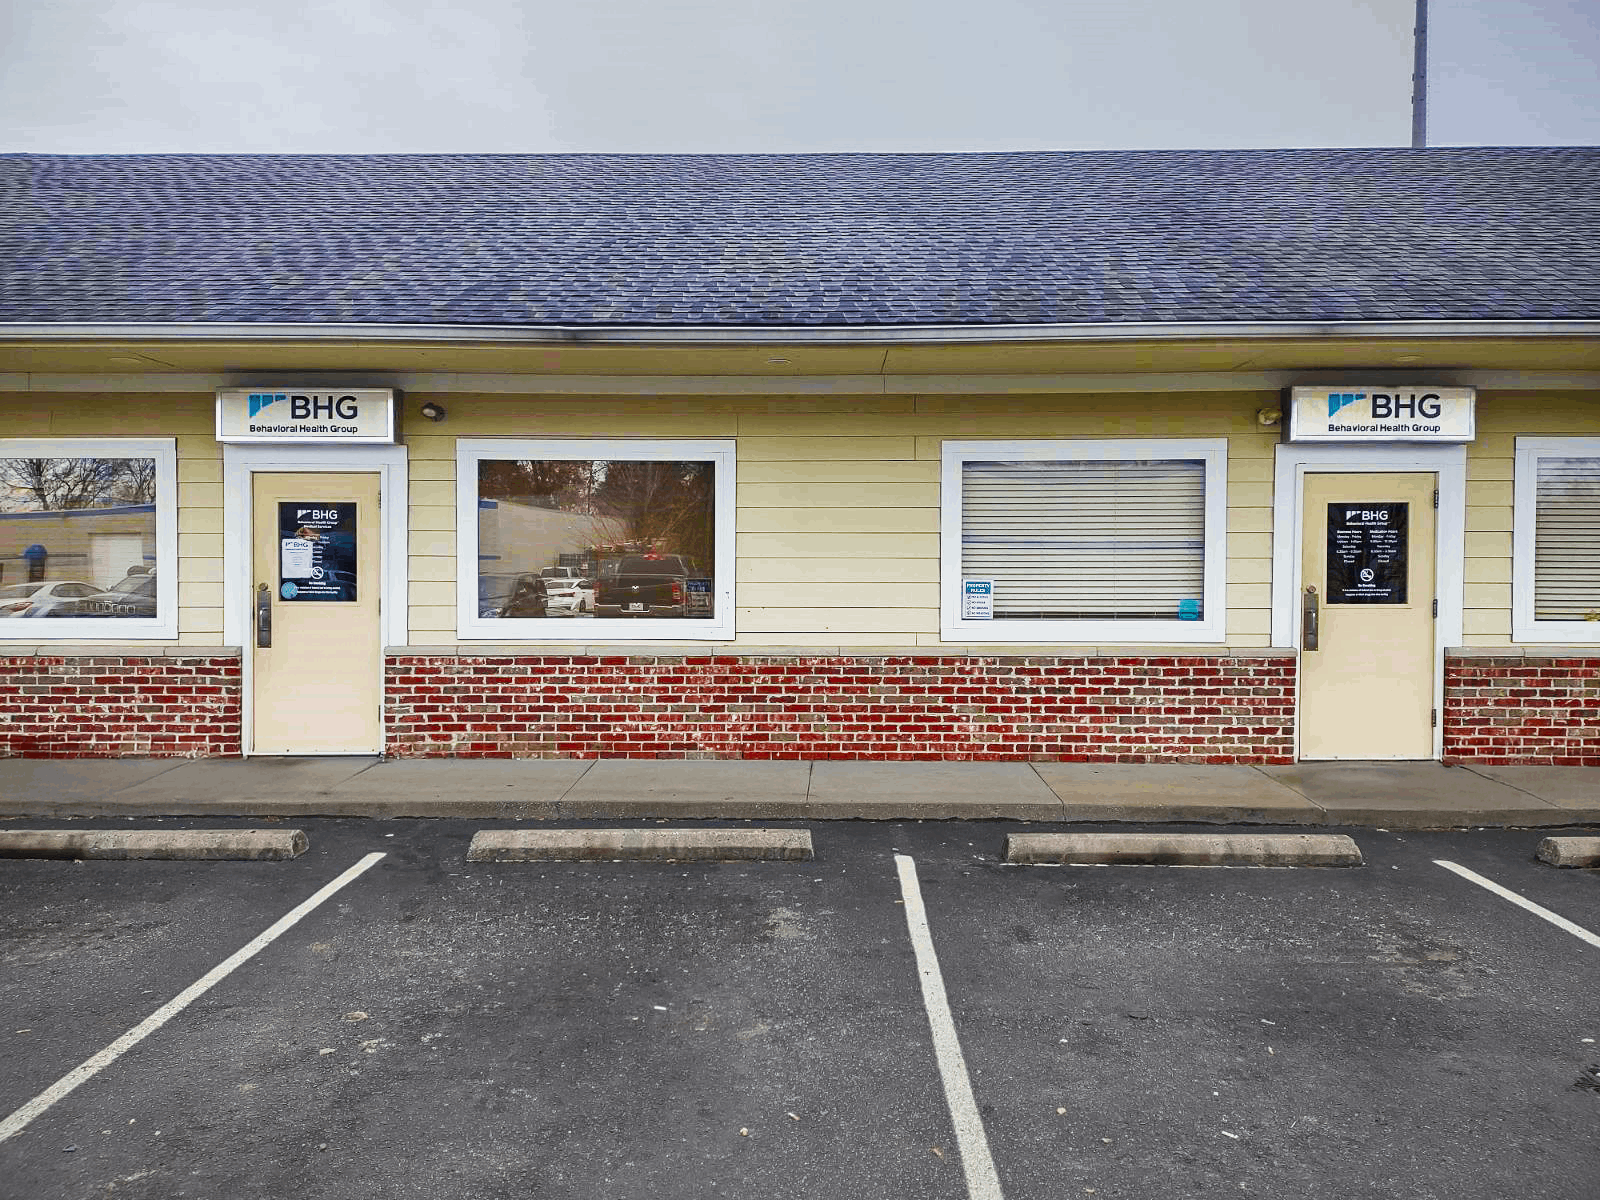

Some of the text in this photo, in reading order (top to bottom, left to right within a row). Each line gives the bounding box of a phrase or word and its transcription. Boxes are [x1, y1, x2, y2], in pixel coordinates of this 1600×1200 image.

[290, 395, 358, 420] BHG
[1371, 393, 1441, 419] BHG
[249, 424, 358, 435] Behavioral Health Group
[1328, 423, 1441, 434] Behavioral Health Group
[312, 509, 338, 520] BHG
[1361, 510, 1389, 521] BHG
